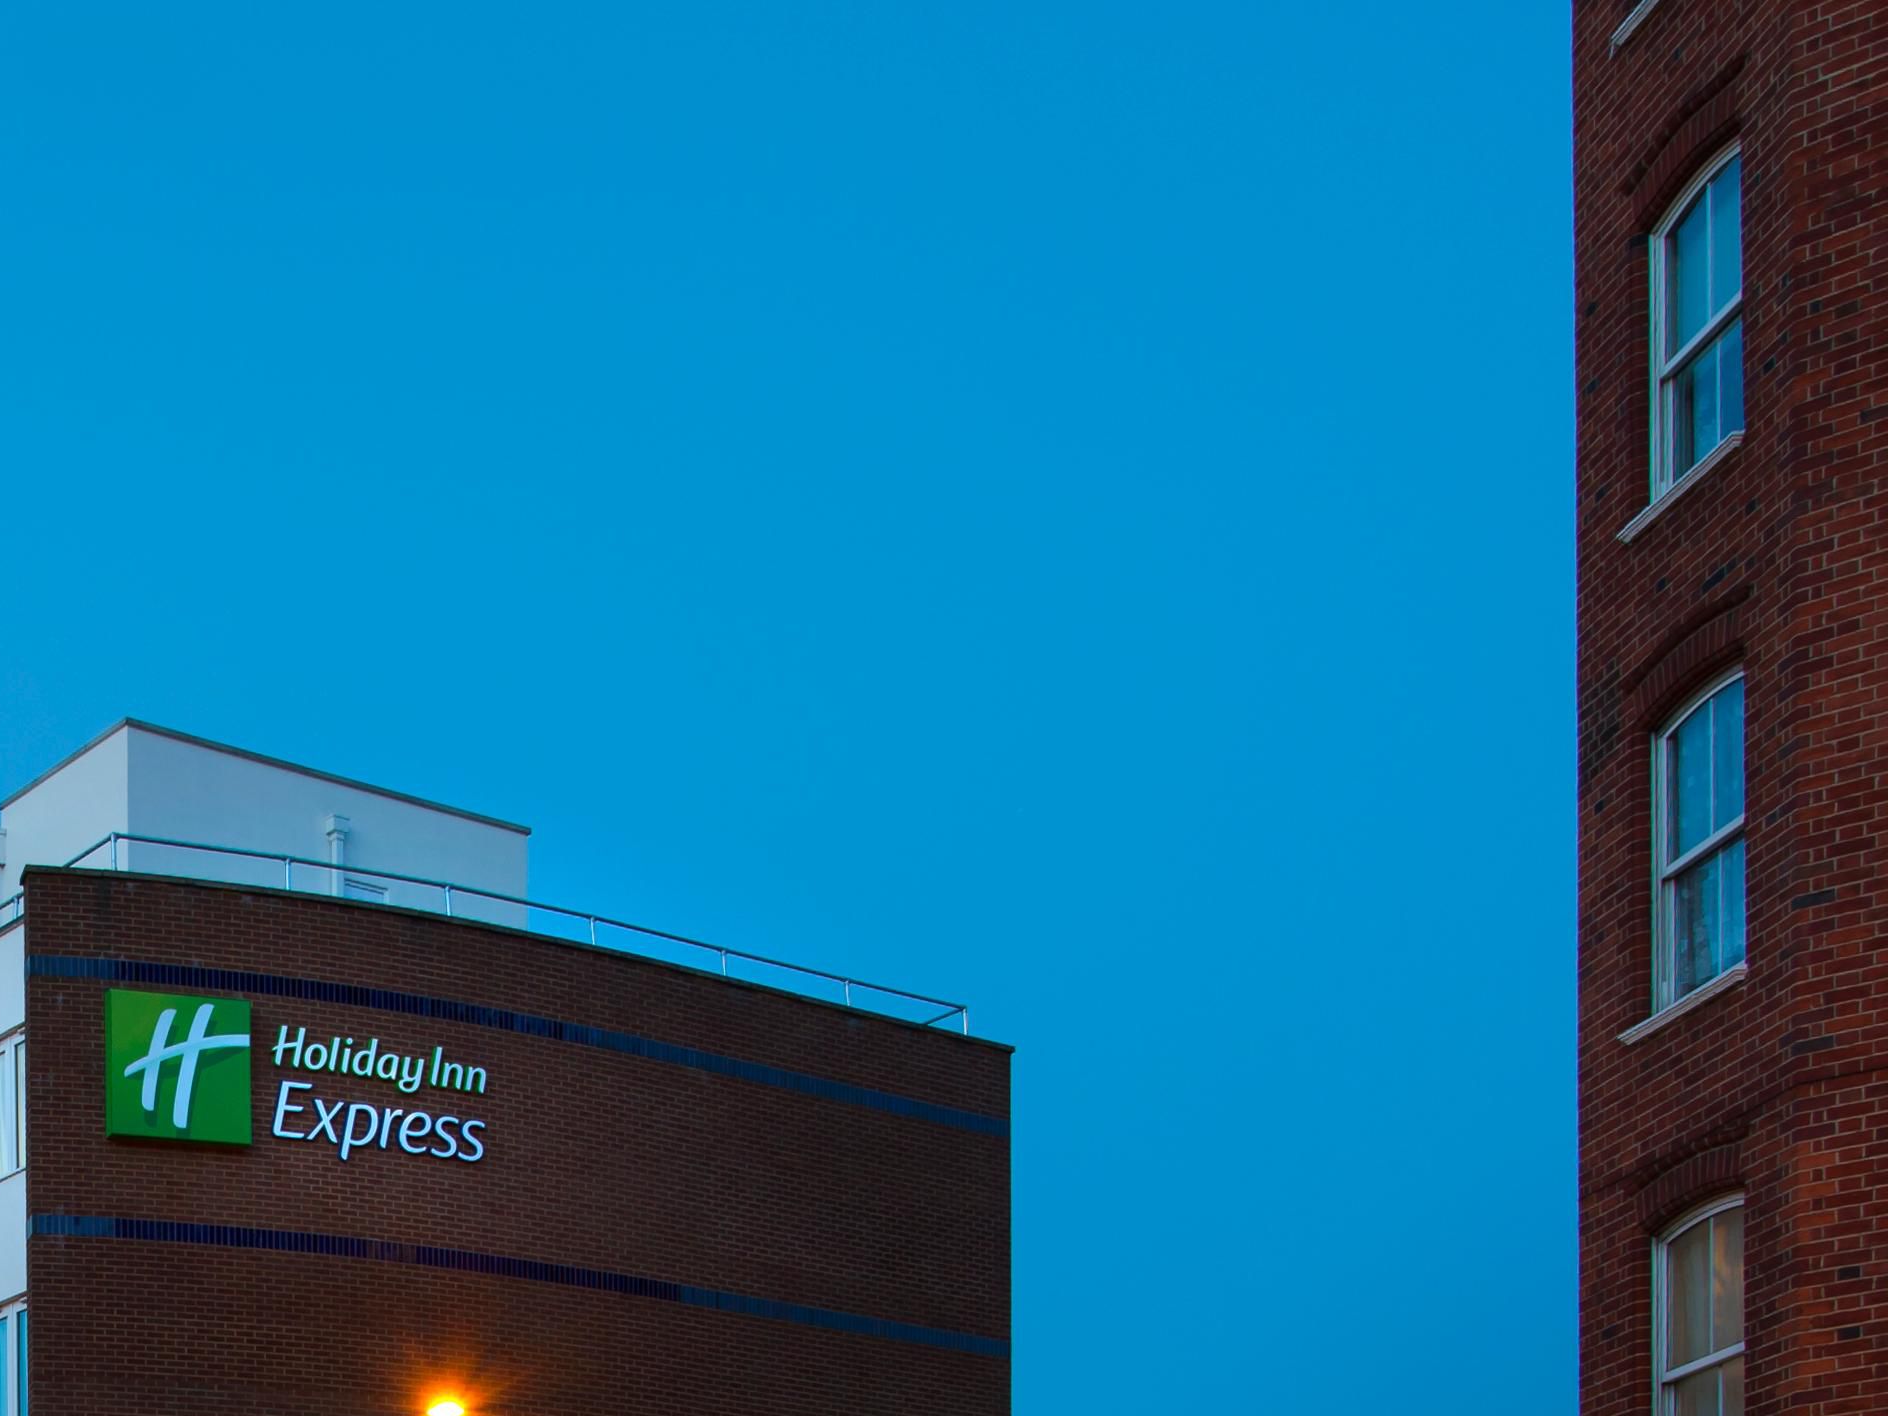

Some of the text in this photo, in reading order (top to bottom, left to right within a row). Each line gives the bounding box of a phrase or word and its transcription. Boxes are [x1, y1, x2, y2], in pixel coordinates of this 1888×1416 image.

[271, 1024, 487, 1094] Holiday Inn
[271, 1080, 486, 1163] Express
